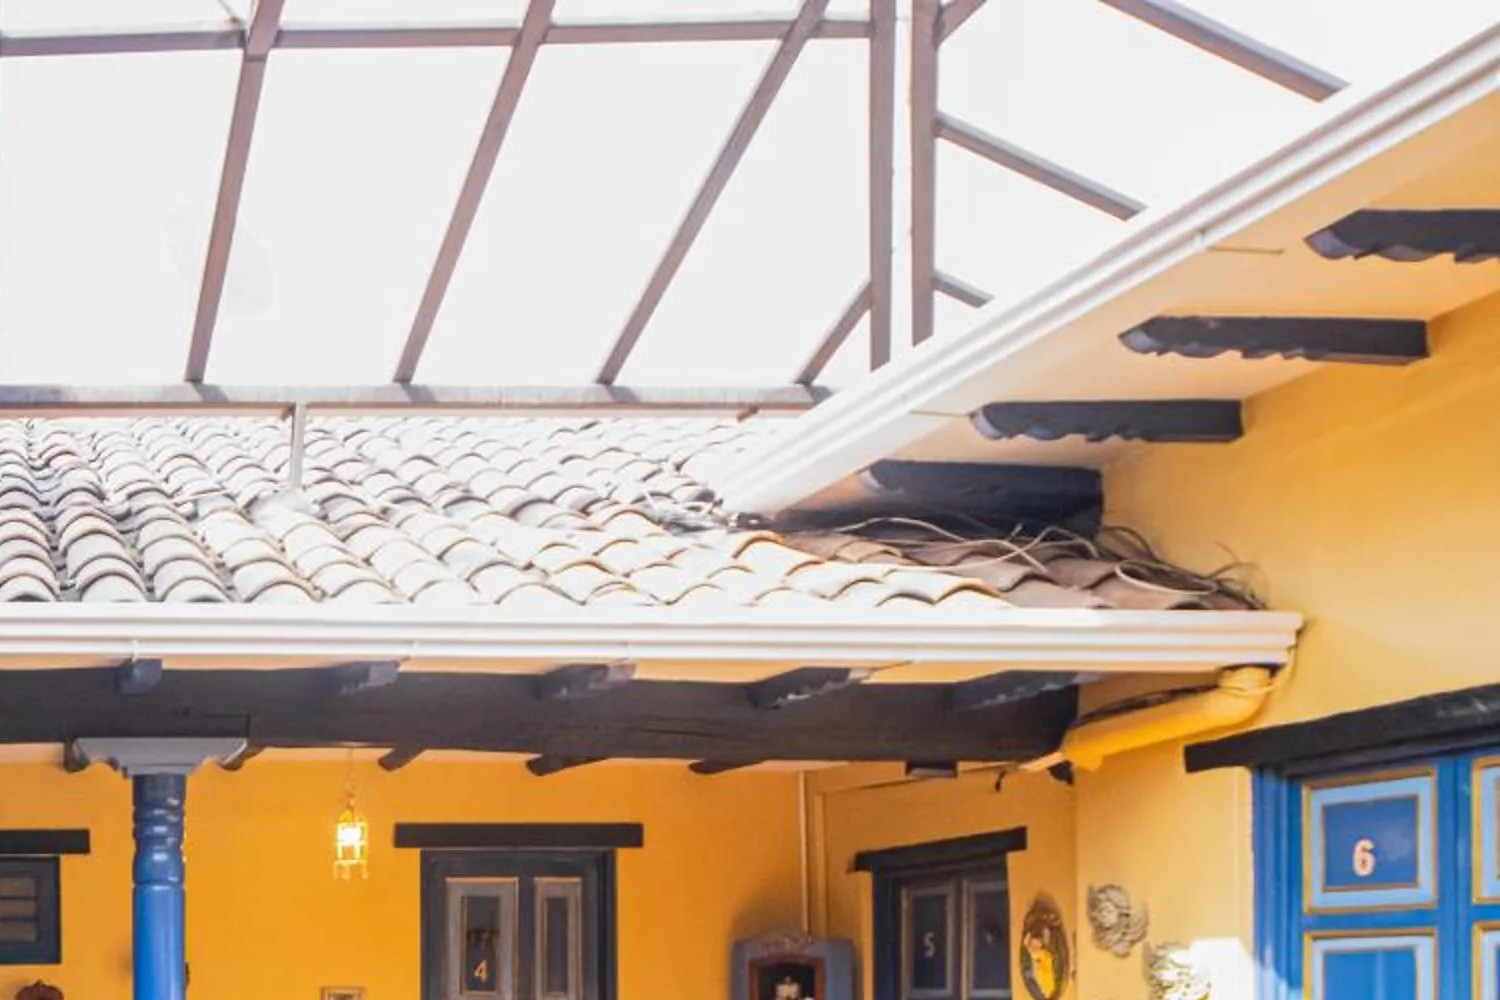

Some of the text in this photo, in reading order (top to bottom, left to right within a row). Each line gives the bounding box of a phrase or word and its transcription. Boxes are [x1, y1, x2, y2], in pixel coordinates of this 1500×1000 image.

[1352, 839, 1376, 877] 6
[923, 931, 936, 958] 5
[473, 960, 488, 983] 4
